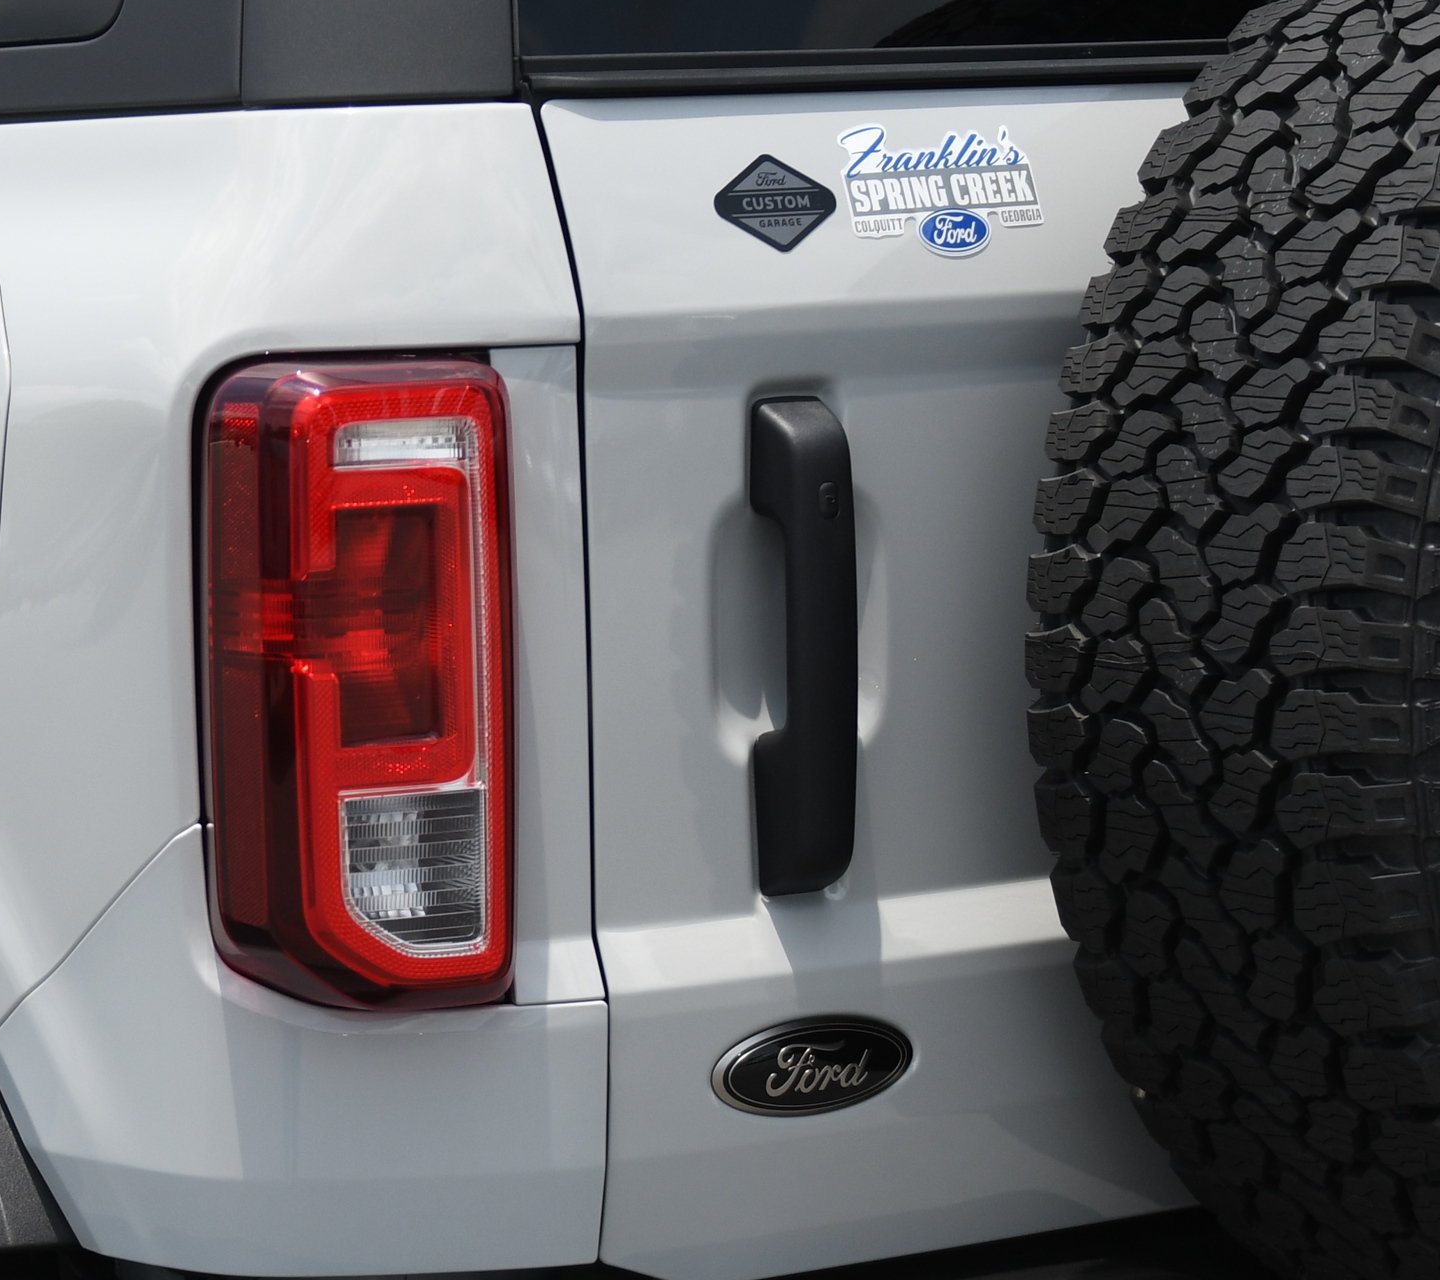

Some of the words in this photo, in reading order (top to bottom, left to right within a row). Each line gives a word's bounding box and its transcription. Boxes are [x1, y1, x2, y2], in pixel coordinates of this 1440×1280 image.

[839, 125, 1025, 179] Franklin's
[754, 170, 788, 188] Ford
[849, 171, 950, 214] SPRING
[950, 169, 1036, 207] CREEK
[741, 194, 811, 212] CUSTOM
[758, 217, 803, 229] GARAGE
[854, 217, 903, 234] COLQUITT
[1000, 209, 1043, 224] GEORGIA
[933, 214, 978, 246] Ford
[765, 1038, 870, 1098] Ford
